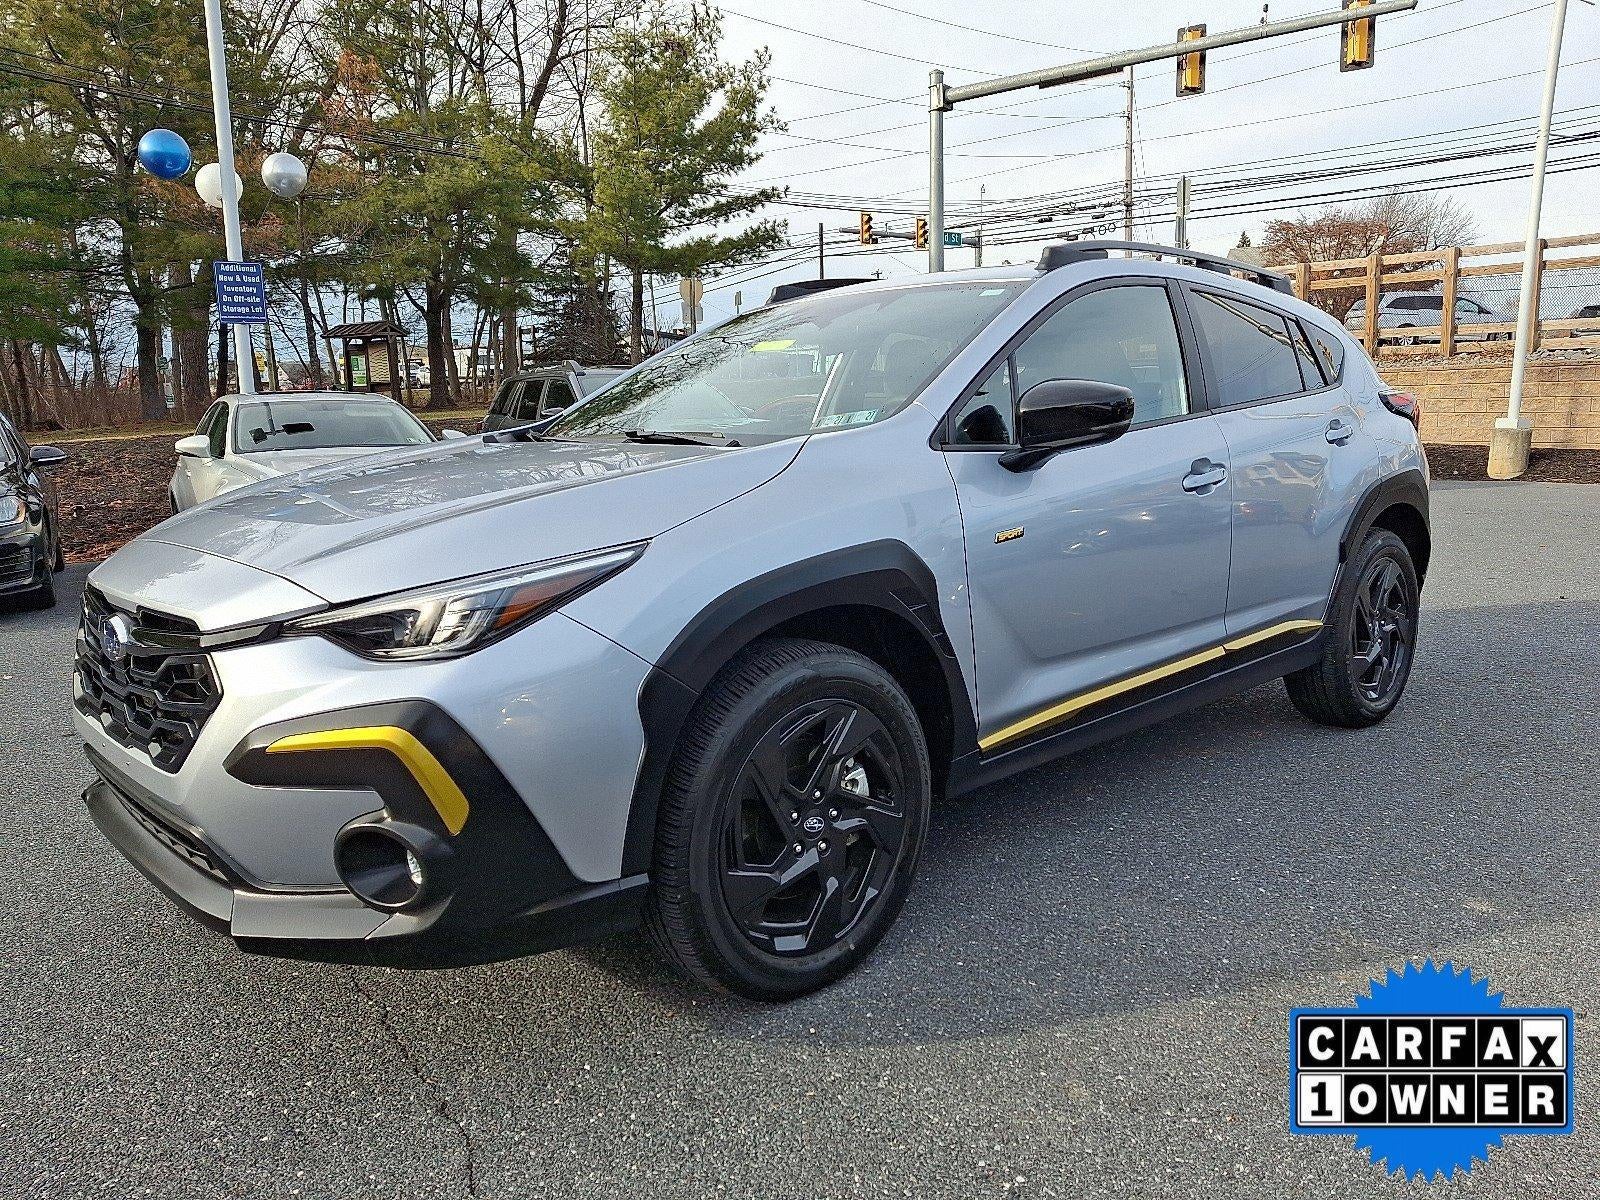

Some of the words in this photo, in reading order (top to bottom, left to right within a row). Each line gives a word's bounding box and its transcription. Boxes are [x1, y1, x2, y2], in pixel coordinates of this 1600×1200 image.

[951, 234, 959, 243] St
[220, 264, 257, 272] Additional
[223, 285, 257, 293] Inventory
[233, 295, 261, 303] Off-site
[222, 305, 250, 313] Storage
[251, 305, 263, 313] Lot
